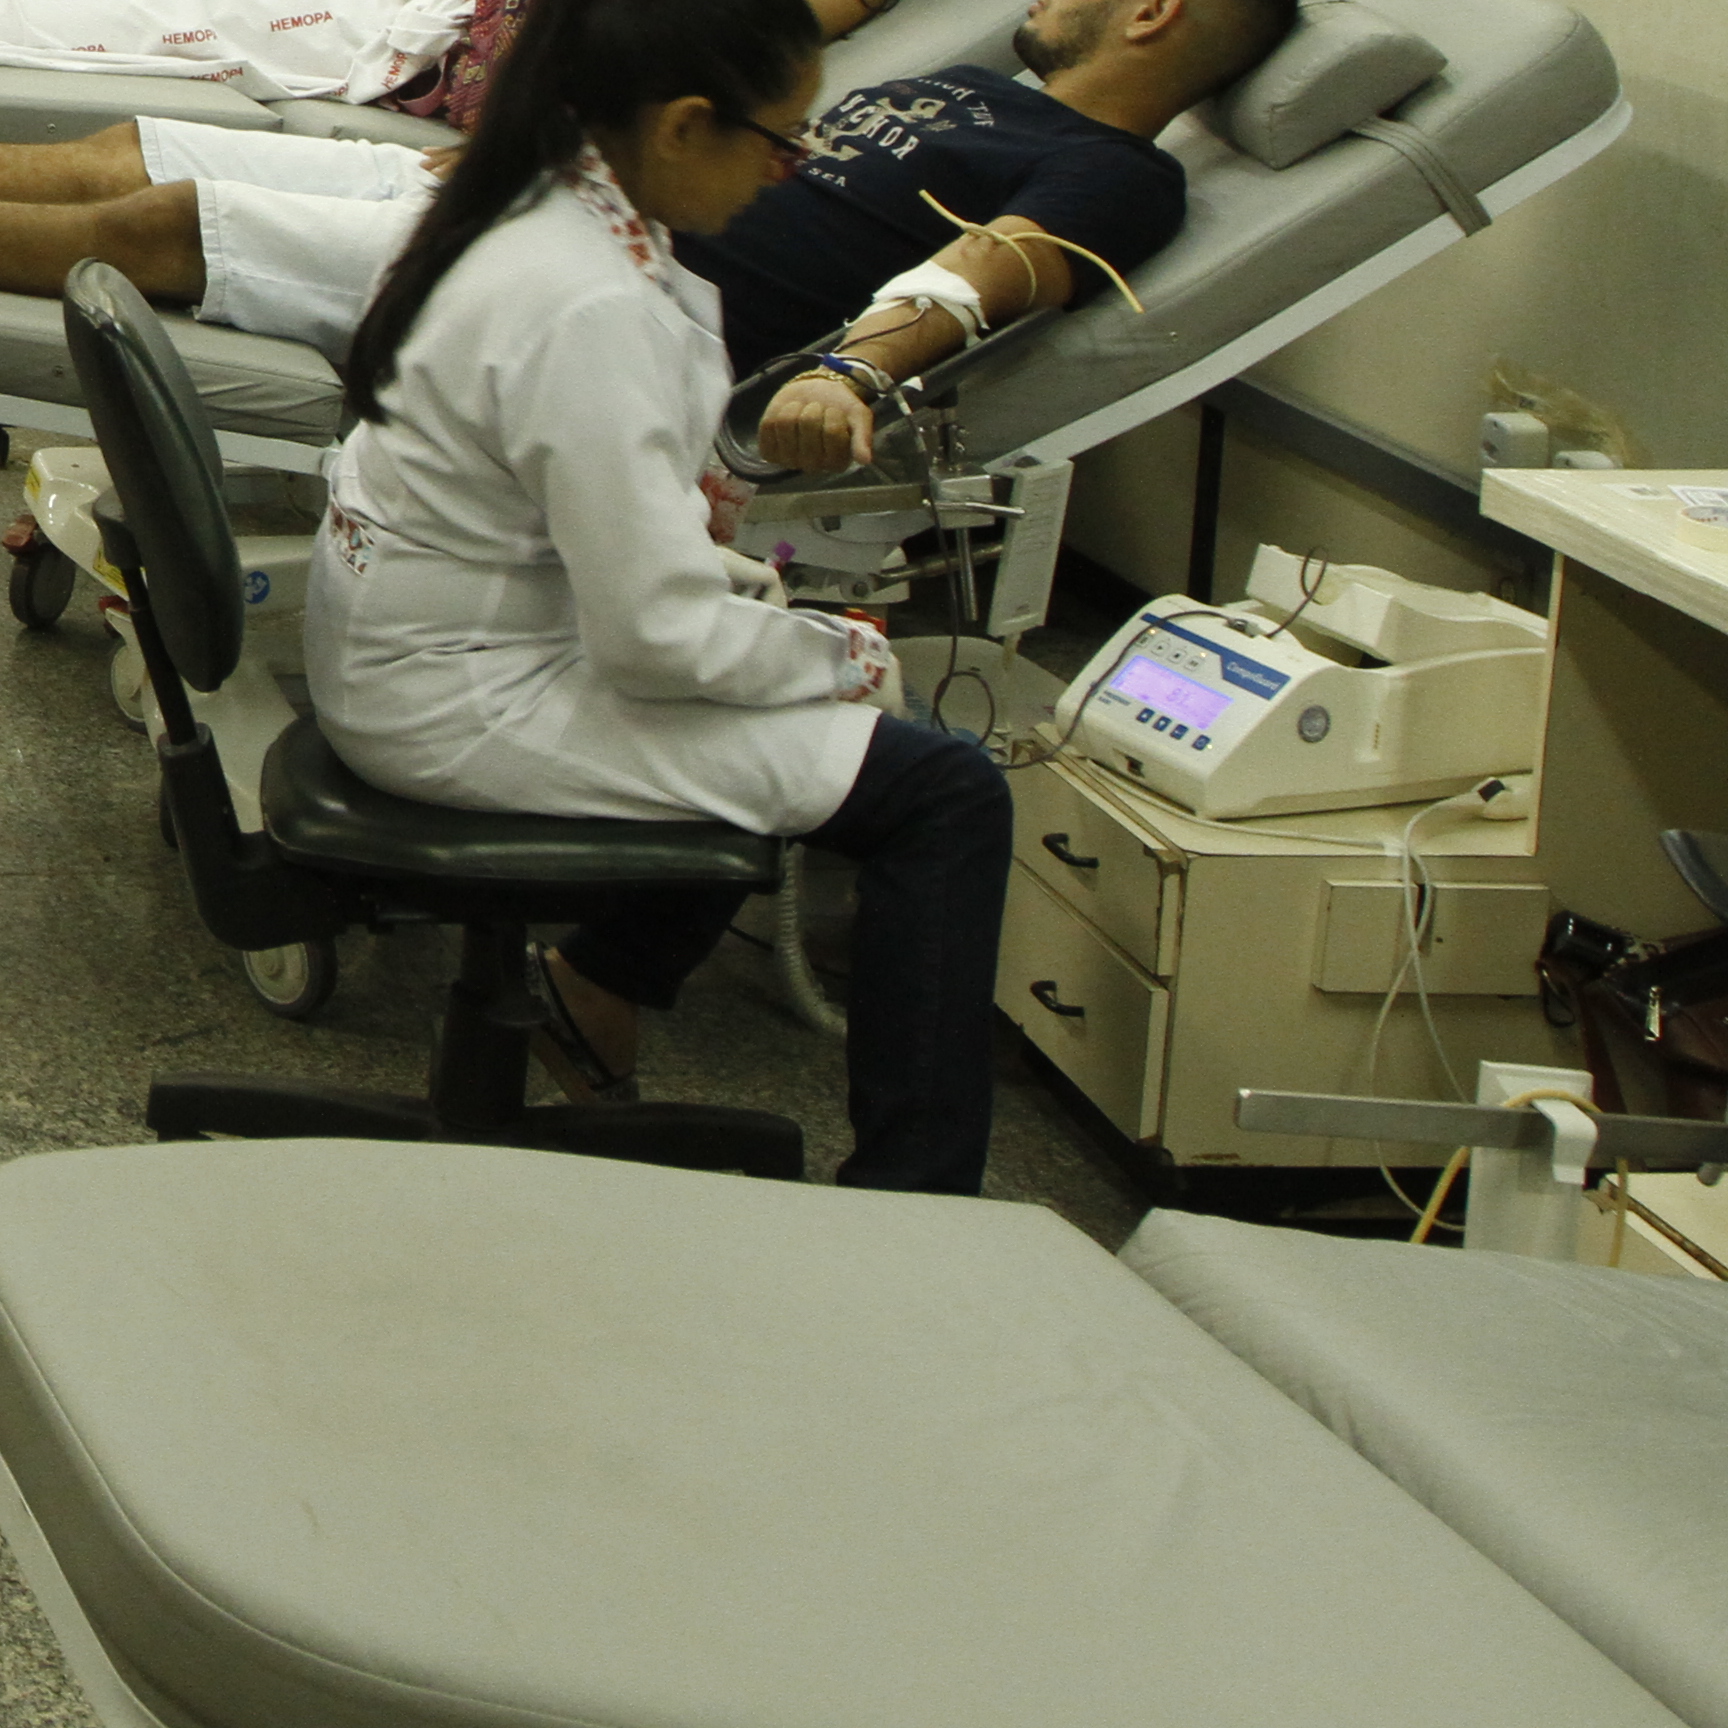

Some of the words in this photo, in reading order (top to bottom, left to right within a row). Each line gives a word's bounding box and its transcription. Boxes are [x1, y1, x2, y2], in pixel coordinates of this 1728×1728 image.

[270, 10, 333, 32] HEMOPA
[381, 52, 408, 91] HEMOP
[808, 167, 846, 187] SEA
